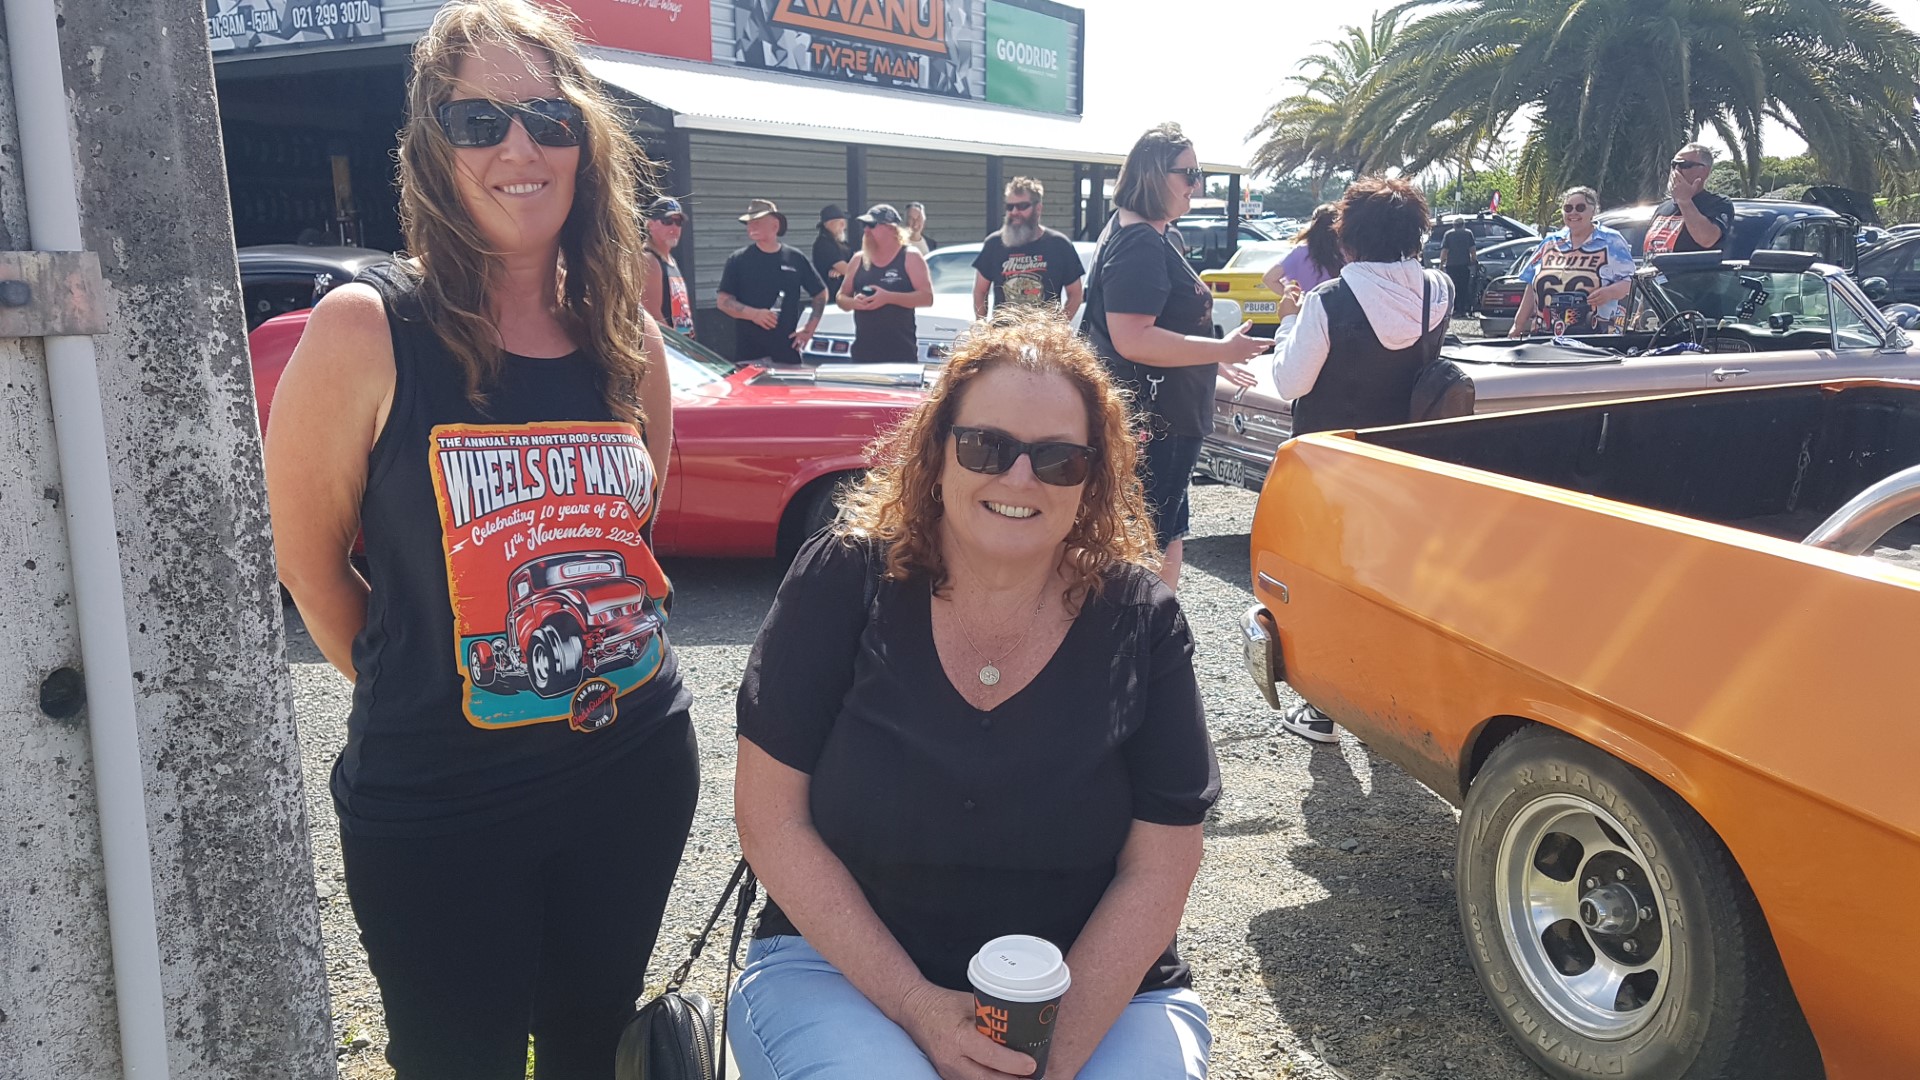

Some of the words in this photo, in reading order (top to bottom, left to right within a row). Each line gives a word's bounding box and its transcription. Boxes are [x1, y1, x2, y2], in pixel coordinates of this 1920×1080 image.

[221, 14, 246, 36] 9AM
[254, 10, 279, 33] 5PM
[292, 7, 312, 29] 021
[316, 3, 338, 26] 299
[340, 0, 371, 24] 3070
[811, 43, 868, 72] TYRE
[874, 54, 919, 80] MAN
[997, 38, 1058, 71] GOODRIDE
[1544, 254, 1601, 268] ROUTE
[438, 437, 462, 448] THE
[465, 436, 508, 447] ANNUAL
[509, 436, 529, 446] FAR
[531, 434, 566, 445] NORTH
[569, 433, 589, 444] ROD
[591, 433, 597, 443] &
[600, 433, 634, 444] CUSTOM
[439, 448, 545, 527] WHEELS
[547, 447, 577, 496] OF
[471, 508, 535, 546] Celebrating
[540, 505, 555, 521] 10
[558, 503, 590, 521] years
[594, 503, 607, 519] of
[503, 533, 525, 561] 11th
[527, 522, 603, 550] November
[605, 527, 642, 546] 2023
